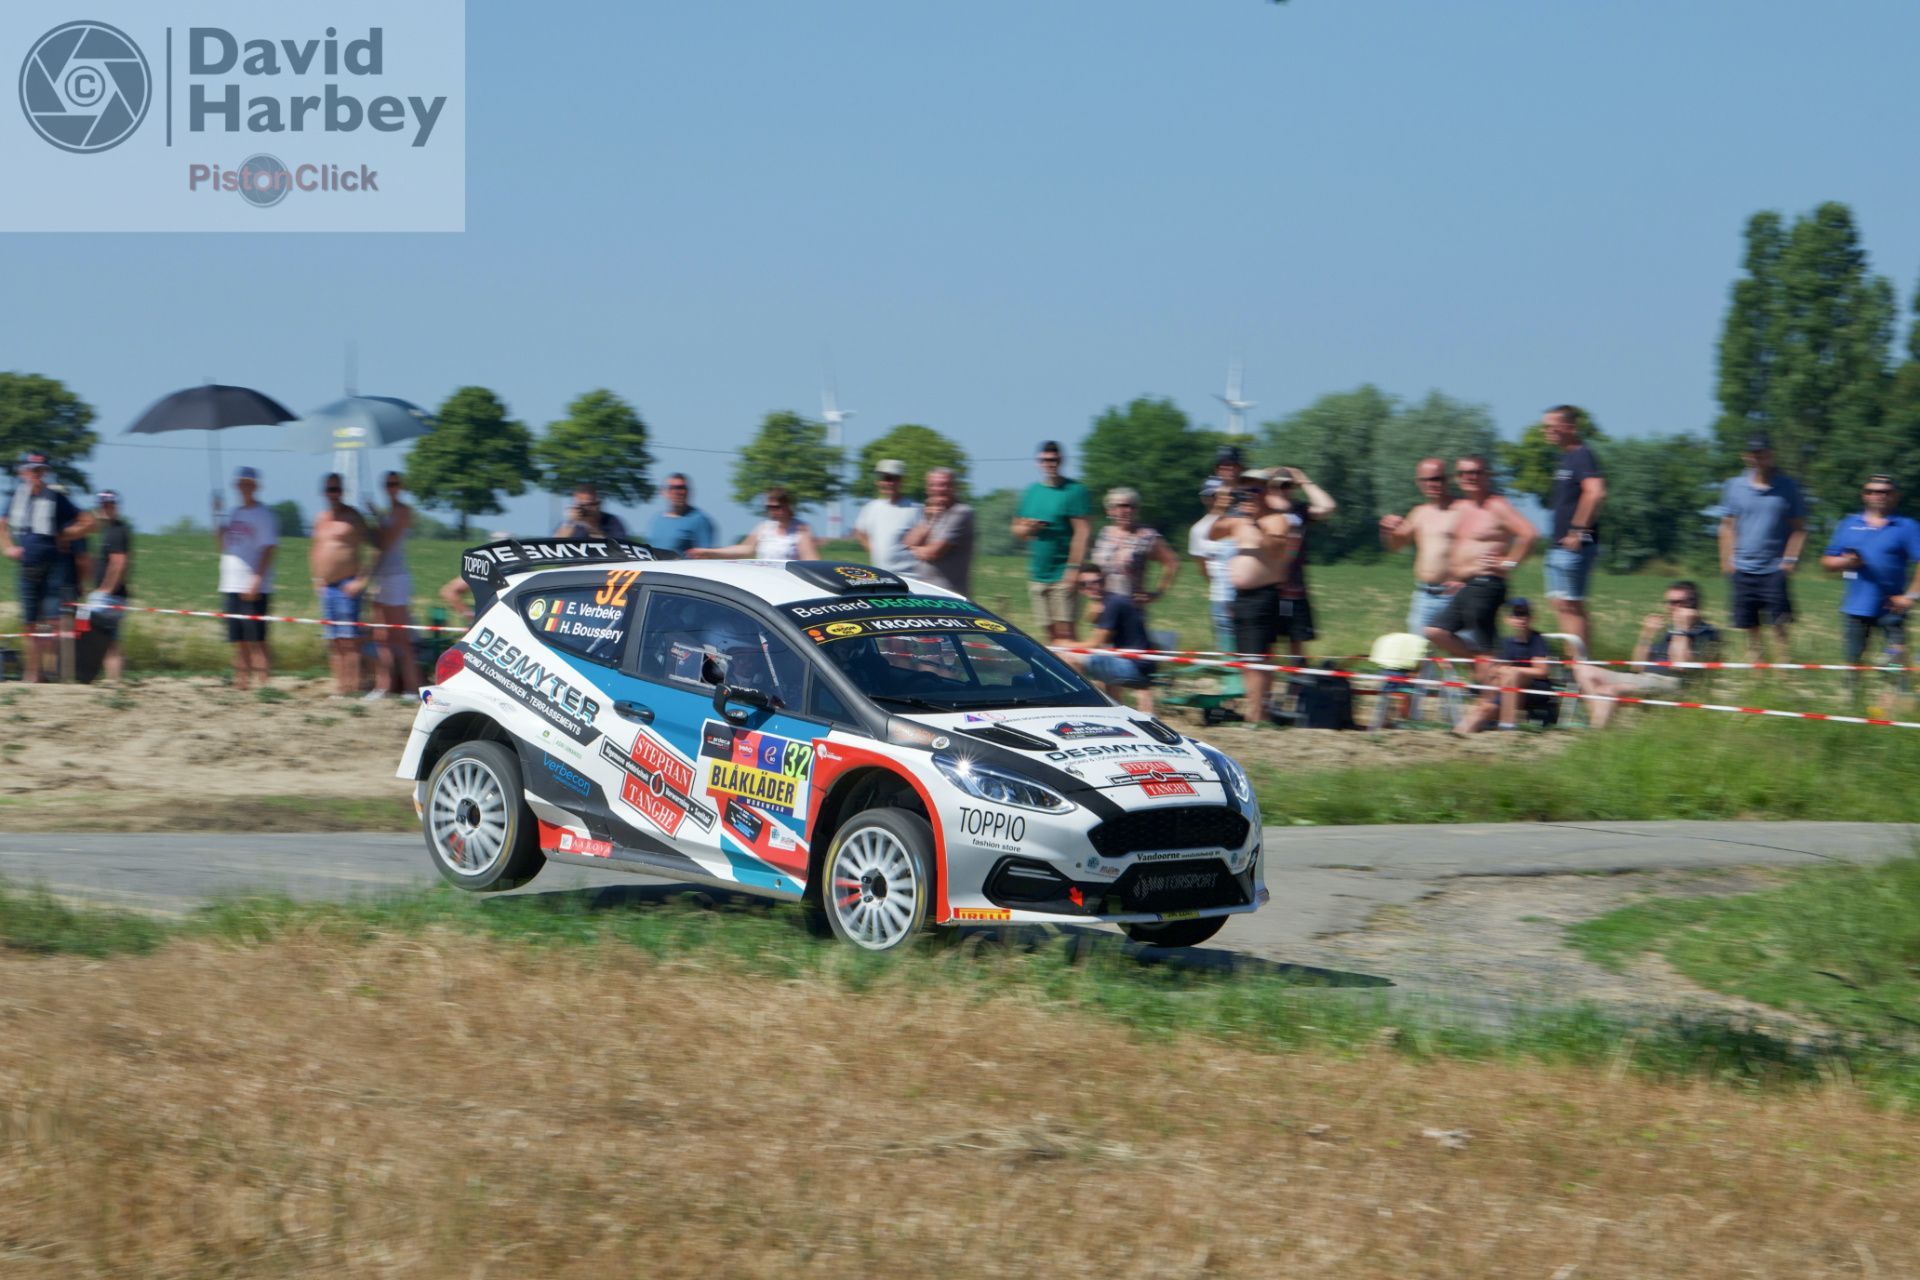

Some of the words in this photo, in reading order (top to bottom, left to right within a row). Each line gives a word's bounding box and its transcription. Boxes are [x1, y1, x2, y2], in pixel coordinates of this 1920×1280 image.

[464, 555, 490, 576] TOPPIO
[595, 569, 642, 607] 32
[566, 602, 577, 615] E.
[579, 603, 623, 620] Verbeke
[792, 599, 872, 618] Bernard
[560, 619, 570, 634] H.
[572, 622, 624, 644] Boussery
[871, 618, 968, 630] KROON-OIL
[469, 627, 600, 727] DESMYTER
[635, 738, 691, 788] STEPHAN
[784, 743, 813, 781] 32
[1045, 744, 1191, 761] DESMYTER
[543, 751, 591, 798] verbecon
[711, 764, 796, 804] BLÅKLÄDER
[629, 783, 677, 831] TANGHE
[960, 806, 1026, 842] TOPPIO
[973, 838, 1000, 849] fashion
[1002, 844, 1021, 852] store
[1137, 852, 1181, 862] Vandoorne
